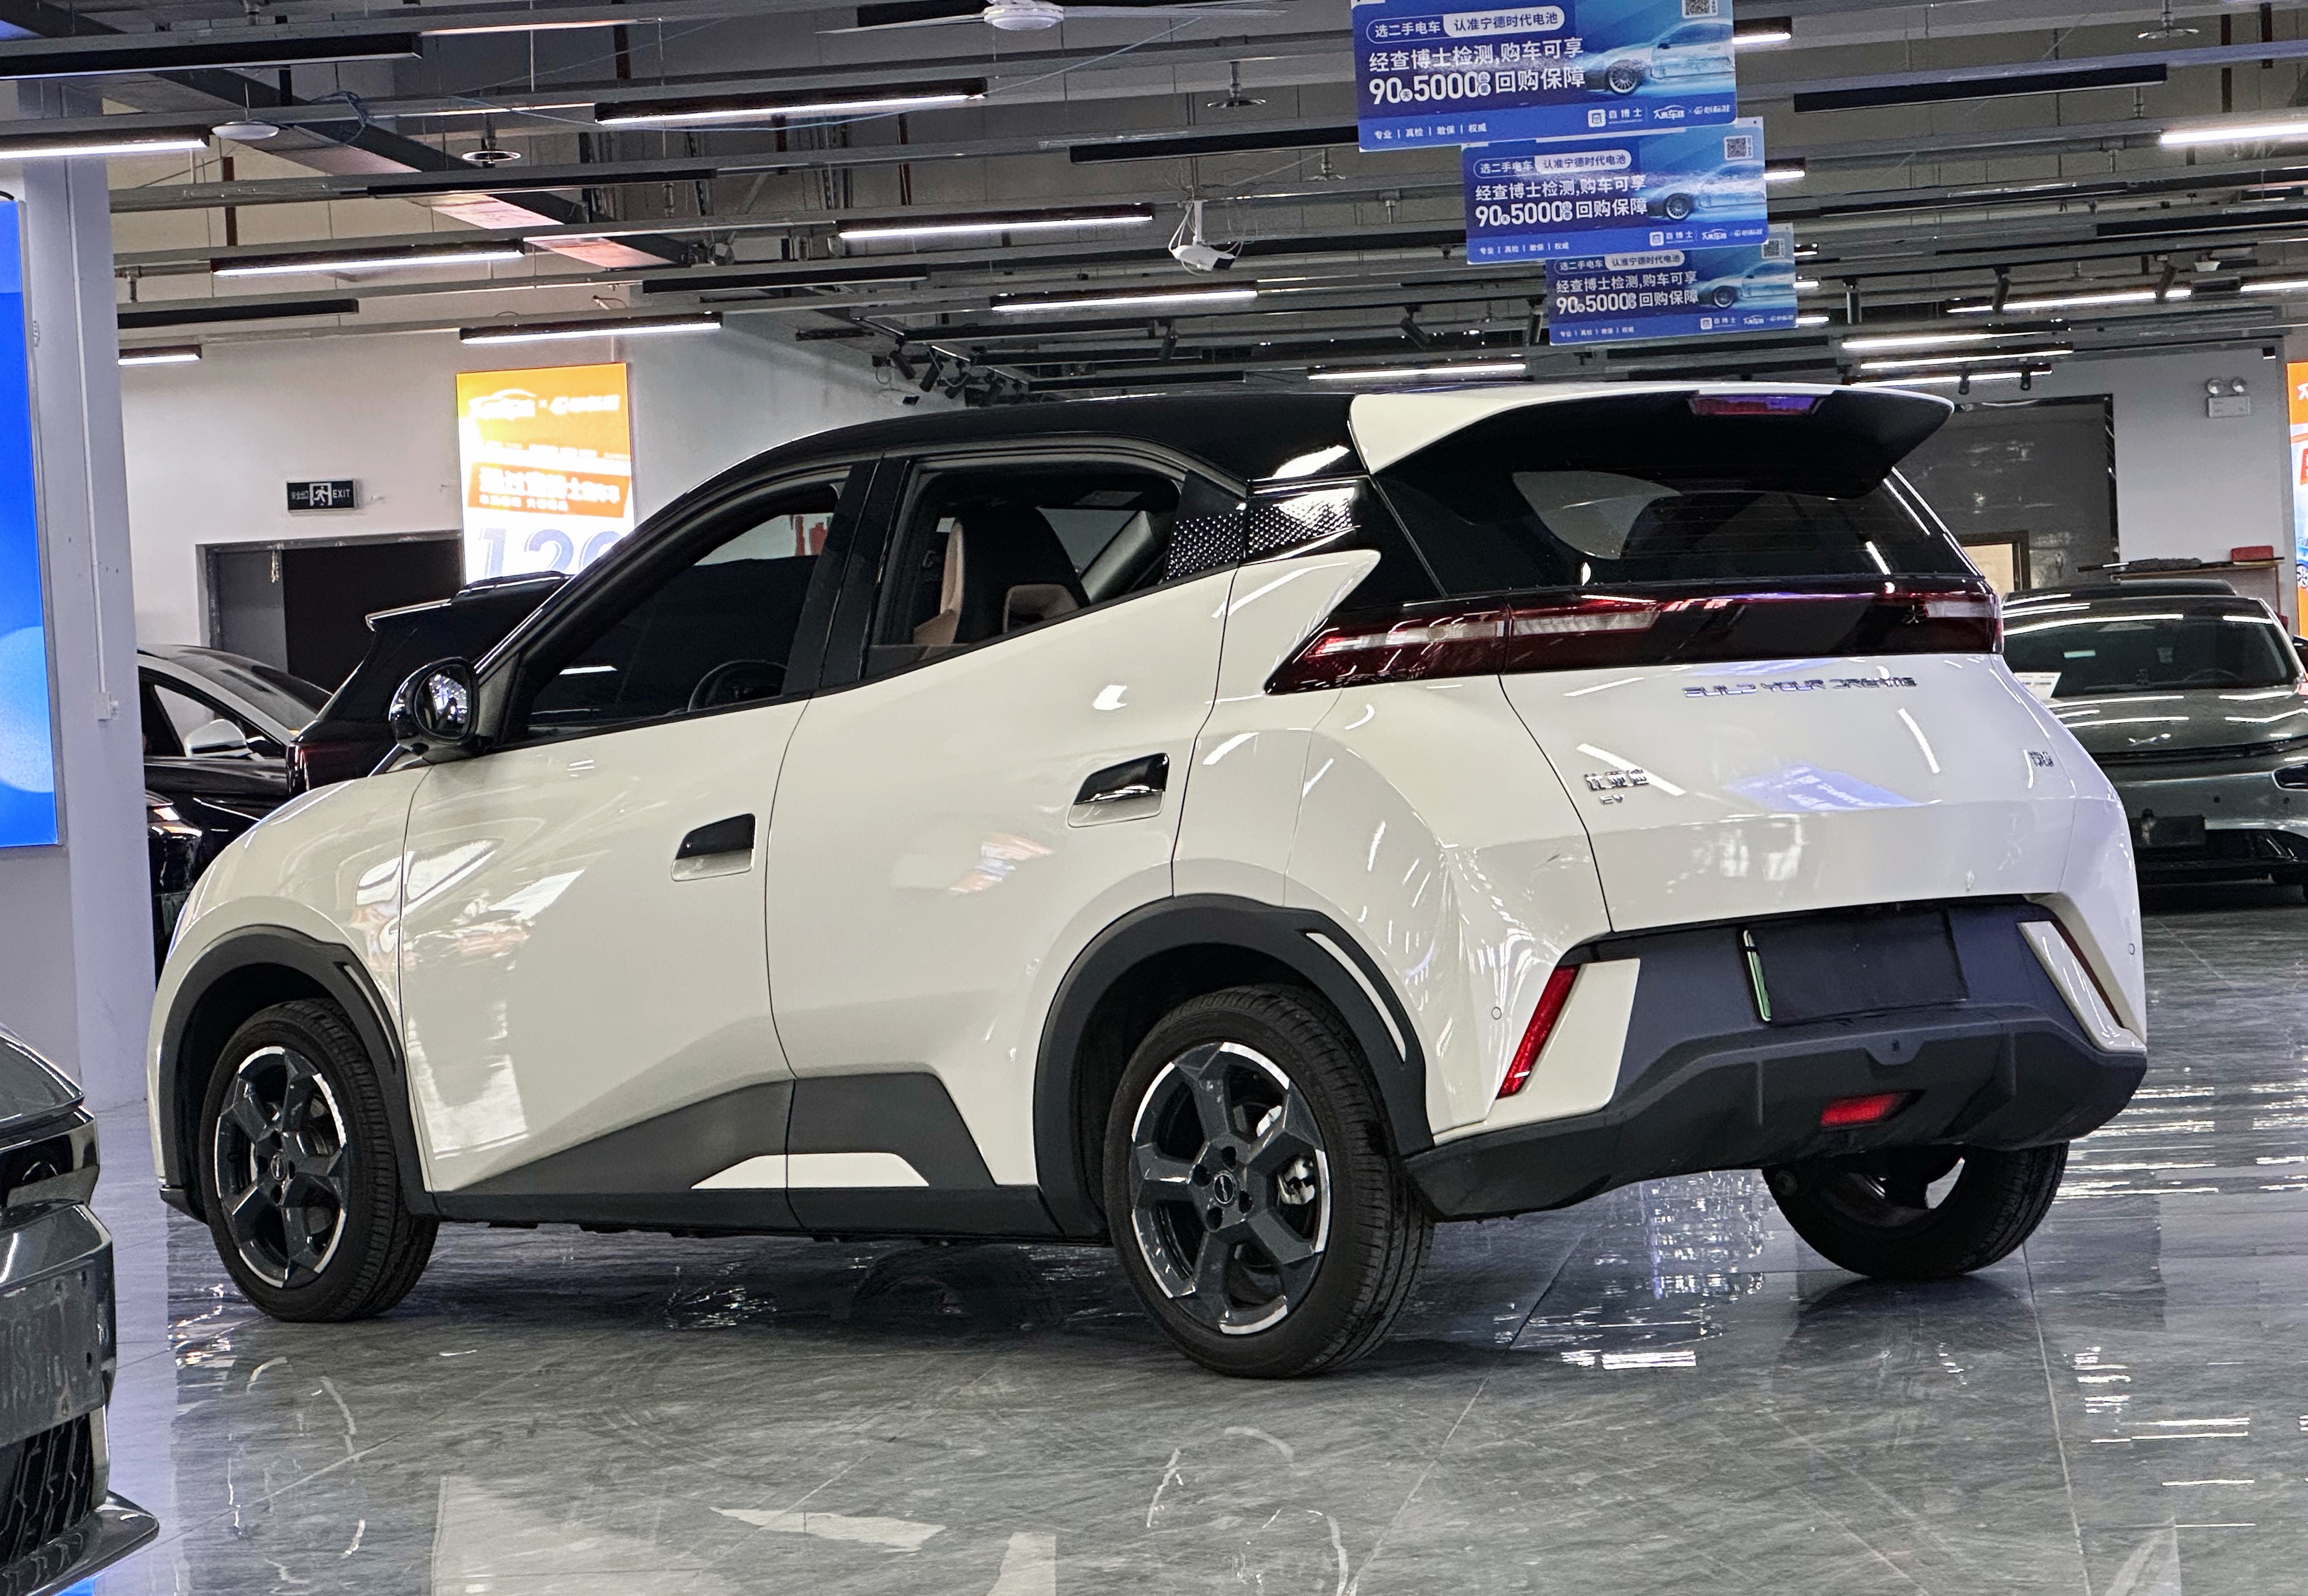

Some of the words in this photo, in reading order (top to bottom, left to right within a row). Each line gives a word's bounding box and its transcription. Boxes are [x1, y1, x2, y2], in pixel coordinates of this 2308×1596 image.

[1375, 20, 1441, 37] 选二手电车
[1454, 12, 1558, 32] 认准宁德时代电池
[1369, 37, 1584, 72] 经查博士检测,购车可享
[1480, 160, 1533, 174] 选二手电车
[1543, 154, 1626, 169] 认准宁德时代电池
[1475, 175, 1646, 201] 经查博士检测,购车可享
[1560, 259, 1604, 270] 选二手电车
[1611, 255, 1681, 267] 认准宁德时代电池
[1556, 270, 1697, 294] 经查博士检测,购车可享
[332, 488, 350, 499] EXIT
[1682, 683, 1757, 698] BUILD
[1761, 678, 1826, 692] YOUR
[1830, 677, 1918, 689] DREAMS
[1600, 793, 1625, 805] EV
